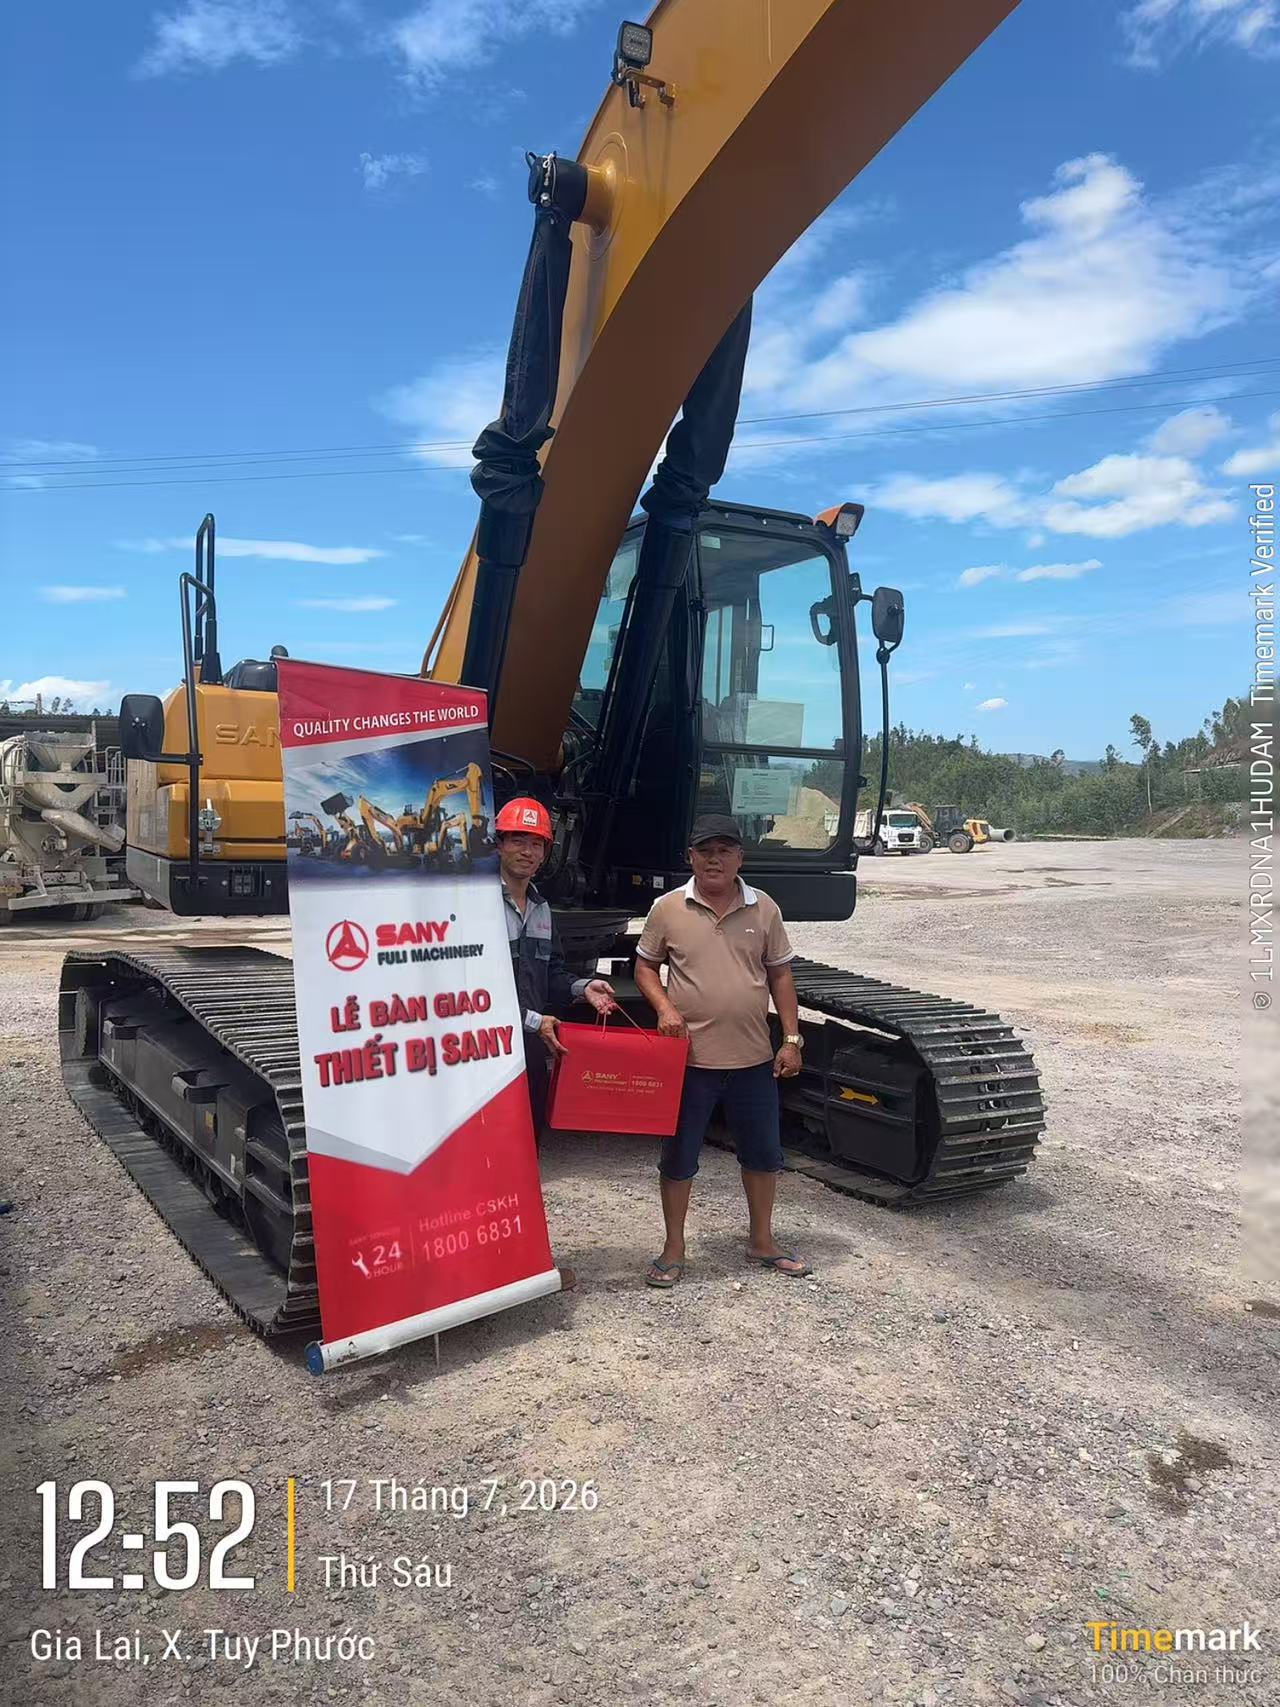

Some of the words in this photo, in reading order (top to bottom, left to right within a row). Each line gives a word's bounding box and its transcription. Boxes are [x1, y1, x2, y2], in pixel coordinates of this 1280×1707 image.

[216, 723, 281, 748] SAN
[293, 718, 350, 737] QUALITY
[353, 712, 411, 730] CHANGES
[413, 710, 436, 724] THE
[437, 705, 479, 722] WORLD
[375, 921, 449, 947] SANY
[377, 950, 408, 966] FULI
[411, 944, 484, 963] MACHINERY
[369, 993, 428, 1028] BÀN
[434, 989, 491, 1018] GIAO
[314, 1033, 398, 1088] THIẾT
[405, 1036, 437, 1076] BỊ
[441, 1025, 513, 1067] SANY
[420, 1210, 472, 1232] Hotline
[476, 1193, 519, 1216] CSKH
[372, 1240, 402, 1267] 24
[423, 1230, 470, 1262] 1800
[476, 1215, 522, 1246] 6831
